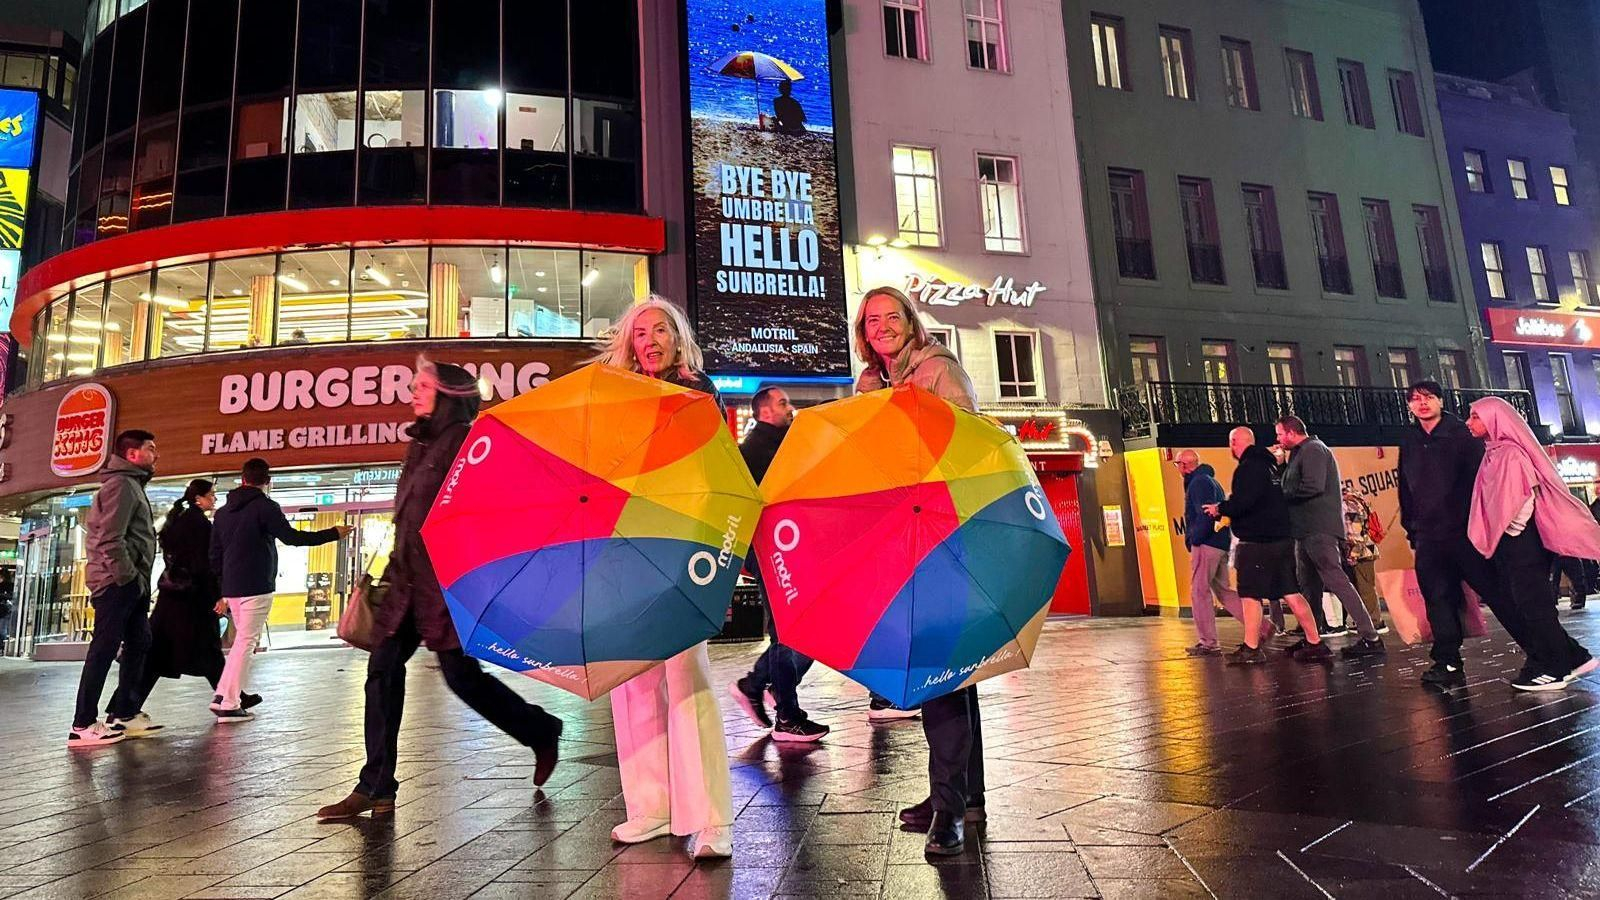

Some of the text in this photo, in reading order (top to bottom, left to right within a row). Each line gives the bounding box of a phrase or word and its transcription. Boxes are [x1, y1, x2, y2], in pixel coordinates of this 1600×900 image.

[721, 164, 813, 202] BYE BYE
[722, 196, 814, 226] UMBRELLA
[720, 222, 819, 272] HELLO
[716, 270, 826, 299] SUNBRELLA!
[905, 273, 1047, 307] Pizza Hut
[750, 327, 799, 341] MOTRIL
[731, 343, 818, 354] ANDALUSIA SPAIN
[219, 361, 550, 414] BURGER NG
[57, 411, 105, 433] BURGER
[55, 429, 104, 457] KING
[201, 428, 285, 455] FLAME
[1359, 468, 1399, 496] SQUAR
[717, 515, 741, 568] motril
[772, 551, 799, 605] motril
[521, 656, 580, 681] sunbrella
[958, 649, 1012, 676] sunbrella
